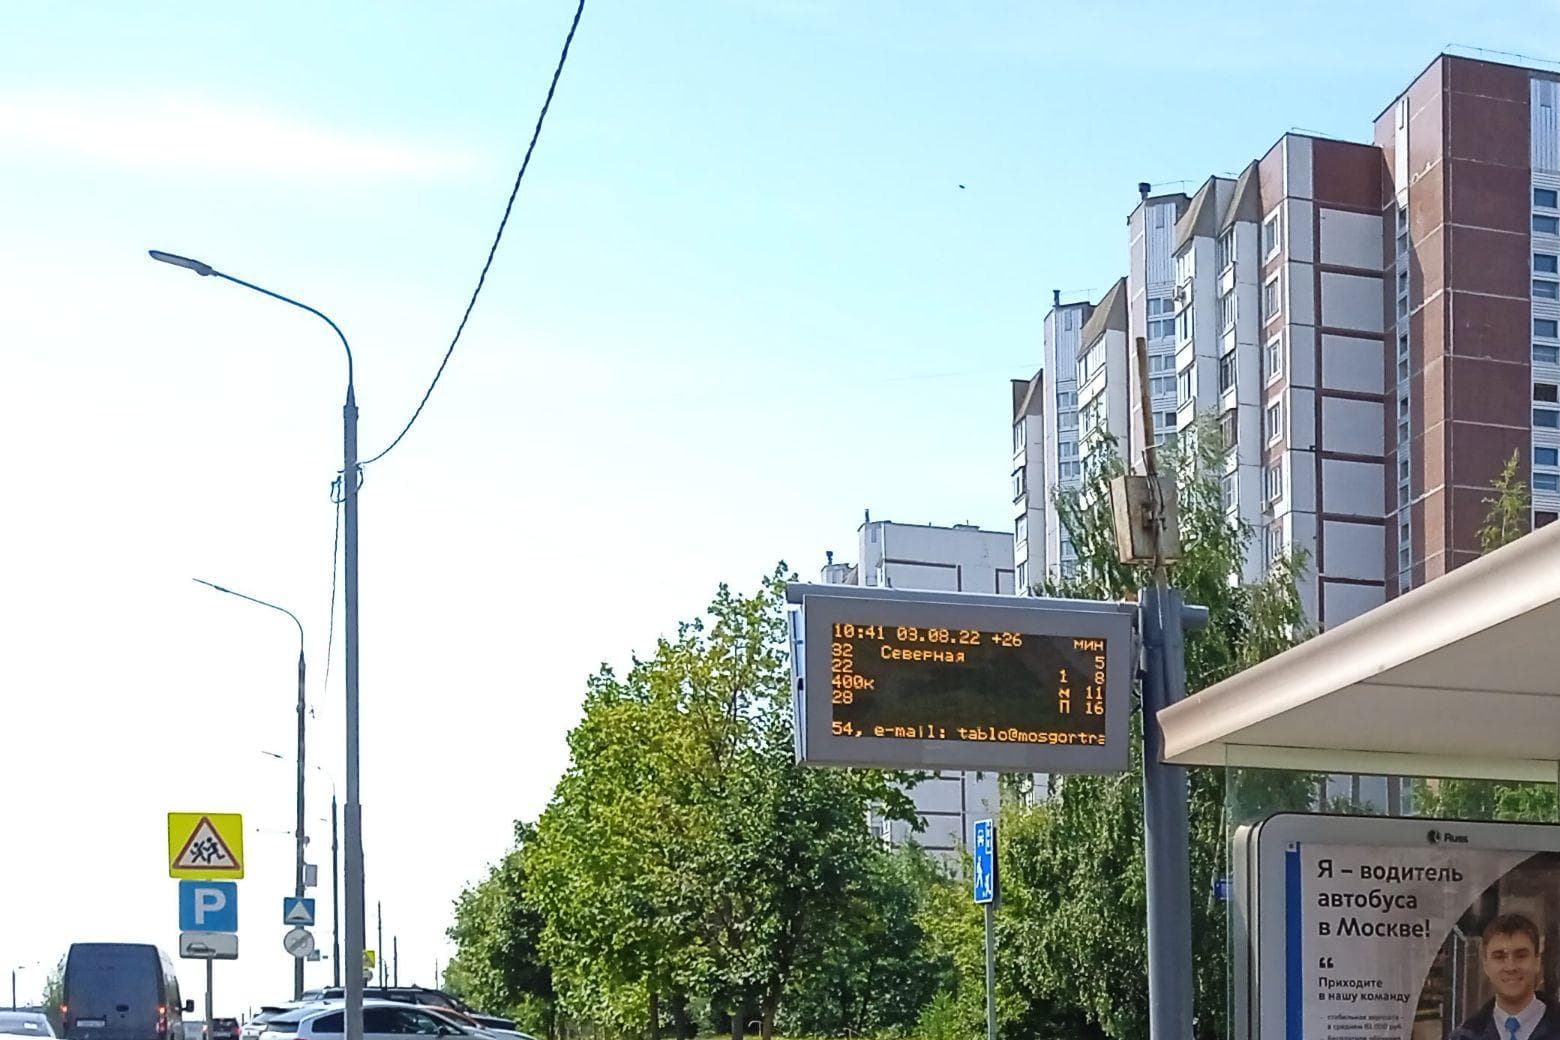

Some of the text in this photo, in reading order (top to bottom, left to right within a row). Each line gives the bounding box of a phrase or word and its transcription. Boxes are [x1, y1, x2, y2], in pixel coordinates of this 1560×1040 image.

[834, 623, 1023, 647] 10:41 03.08.22 +26
[831, 643, 1106, 670] 32 Северная 5
[831, 658, 1105, 685] 22 1 8
[831, 674, 875, 690] 400к
[1085, 685, 1103, 700] 11
[831, 689, 854, 705] 28
[1085, 701, 1104, 716] 16
[831, 721, 863, 738] 54,
[874, 724, 947, 740] e-mail:
[1317, 859, 1333, 879] Я
[1360, 864, 1464, 883] водитель
[193, 888, 227, 925] P
[1317, 888, 1418, 913] автобуса
[1318, 917, 1431, 938] в Москве!
[1318, 976, 1383, 989] Приходите
[1328, 992, 1358, 1002] нашу
[1360, 992, 1411, 1003] команду
